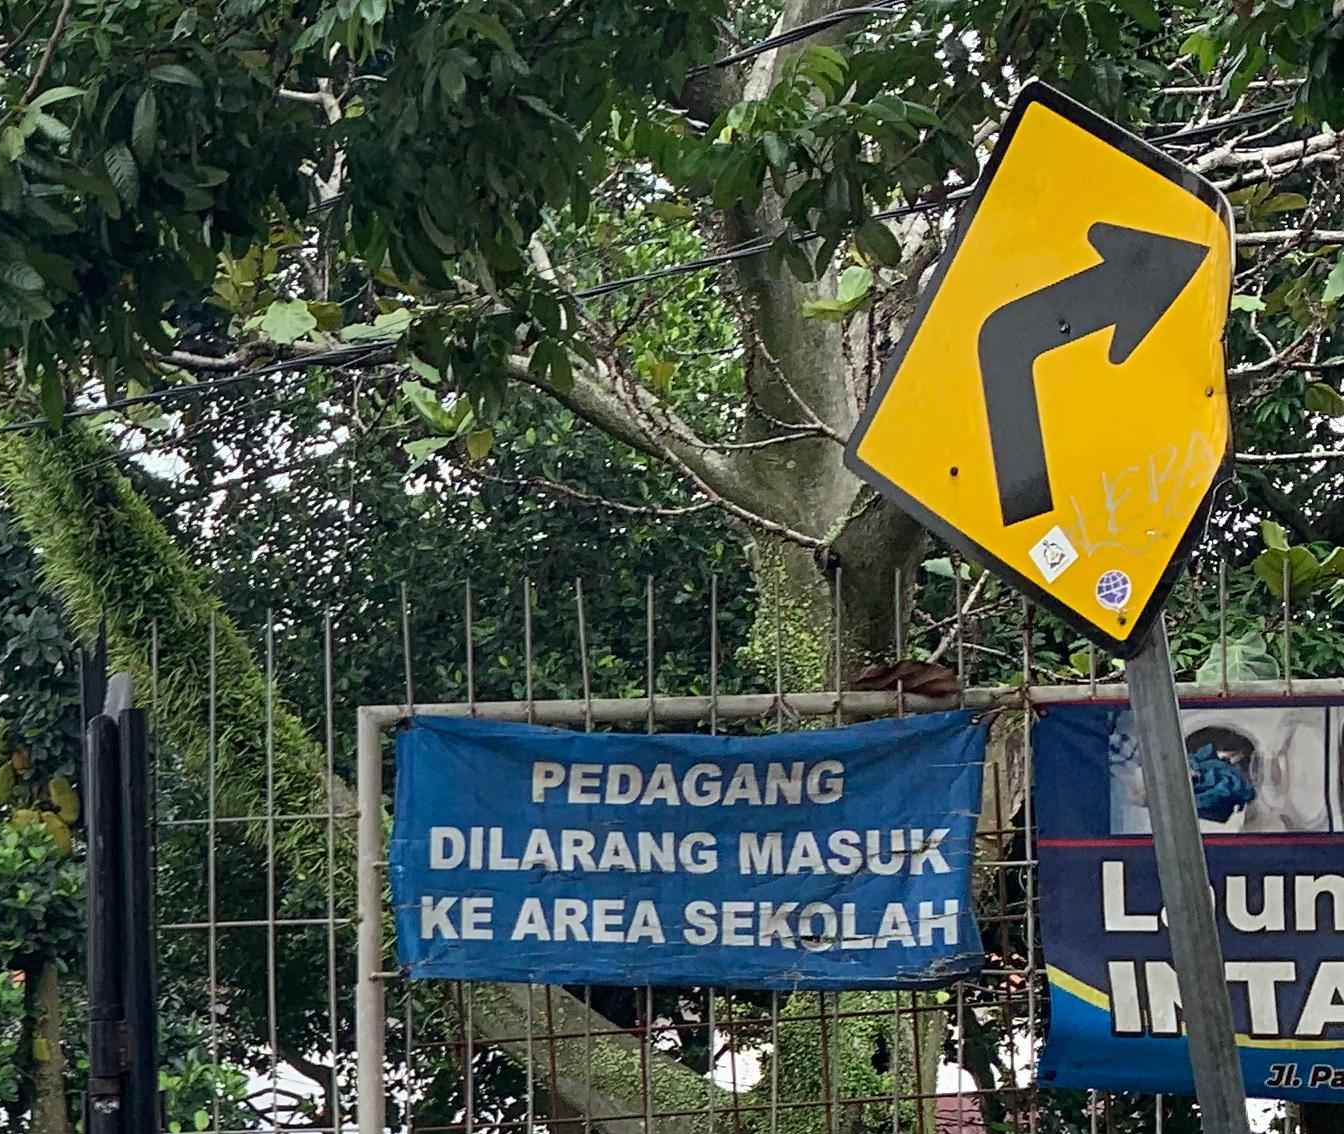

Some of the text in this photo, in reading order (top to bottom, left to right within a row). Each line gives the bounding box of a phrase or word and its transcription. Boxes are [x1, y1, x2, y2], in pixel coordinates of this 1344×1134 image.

[531, 760, 844, 806] PEDAGANG
[429, 827, 951, 876] DILARANG MASUK
[1102, 861, 1344, 933] Lun
[420, 896, 958, 950] KE AREA SEKOLAH
[1265, 1063, 1302, 1088] Jl.
